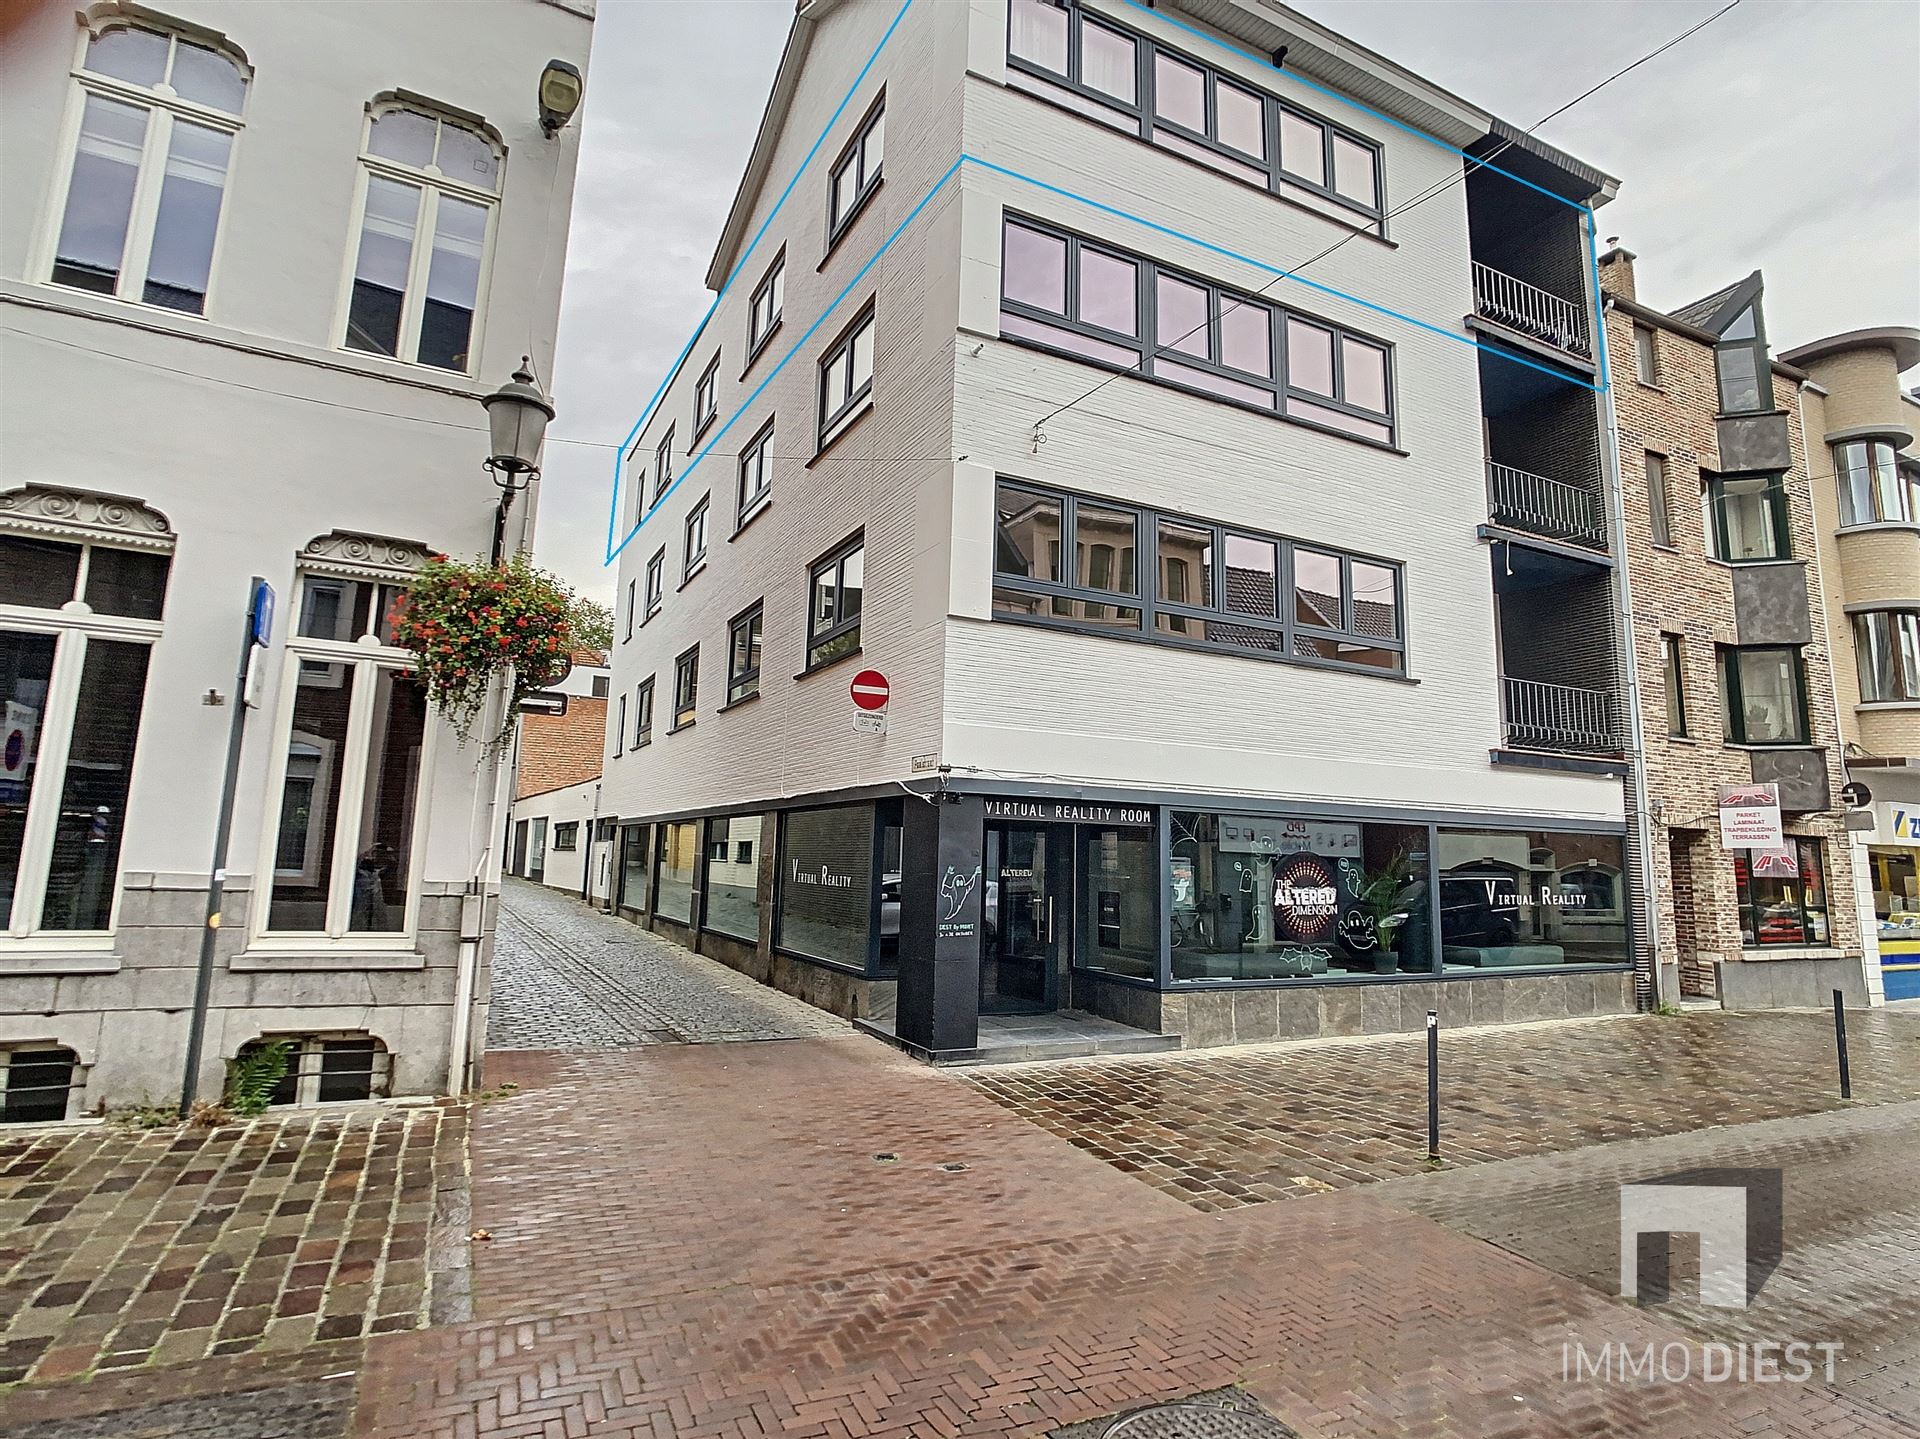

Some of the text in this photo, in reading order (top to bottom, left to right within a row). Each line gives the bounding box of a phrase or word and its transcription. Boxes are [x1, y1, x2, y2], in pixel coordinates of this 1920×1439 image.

[985, 801, 1151, 823] VIRTUAL REALITY ROOM
[1909, 817, 1920, 839] Z
[1001, 869, 1033, 877] ALTERED
[1275, 879, 1292, 889] THE
[1274, 886, 1338, 906] ALTERED
[1291, 904, 1339, 916] DIMENSION
